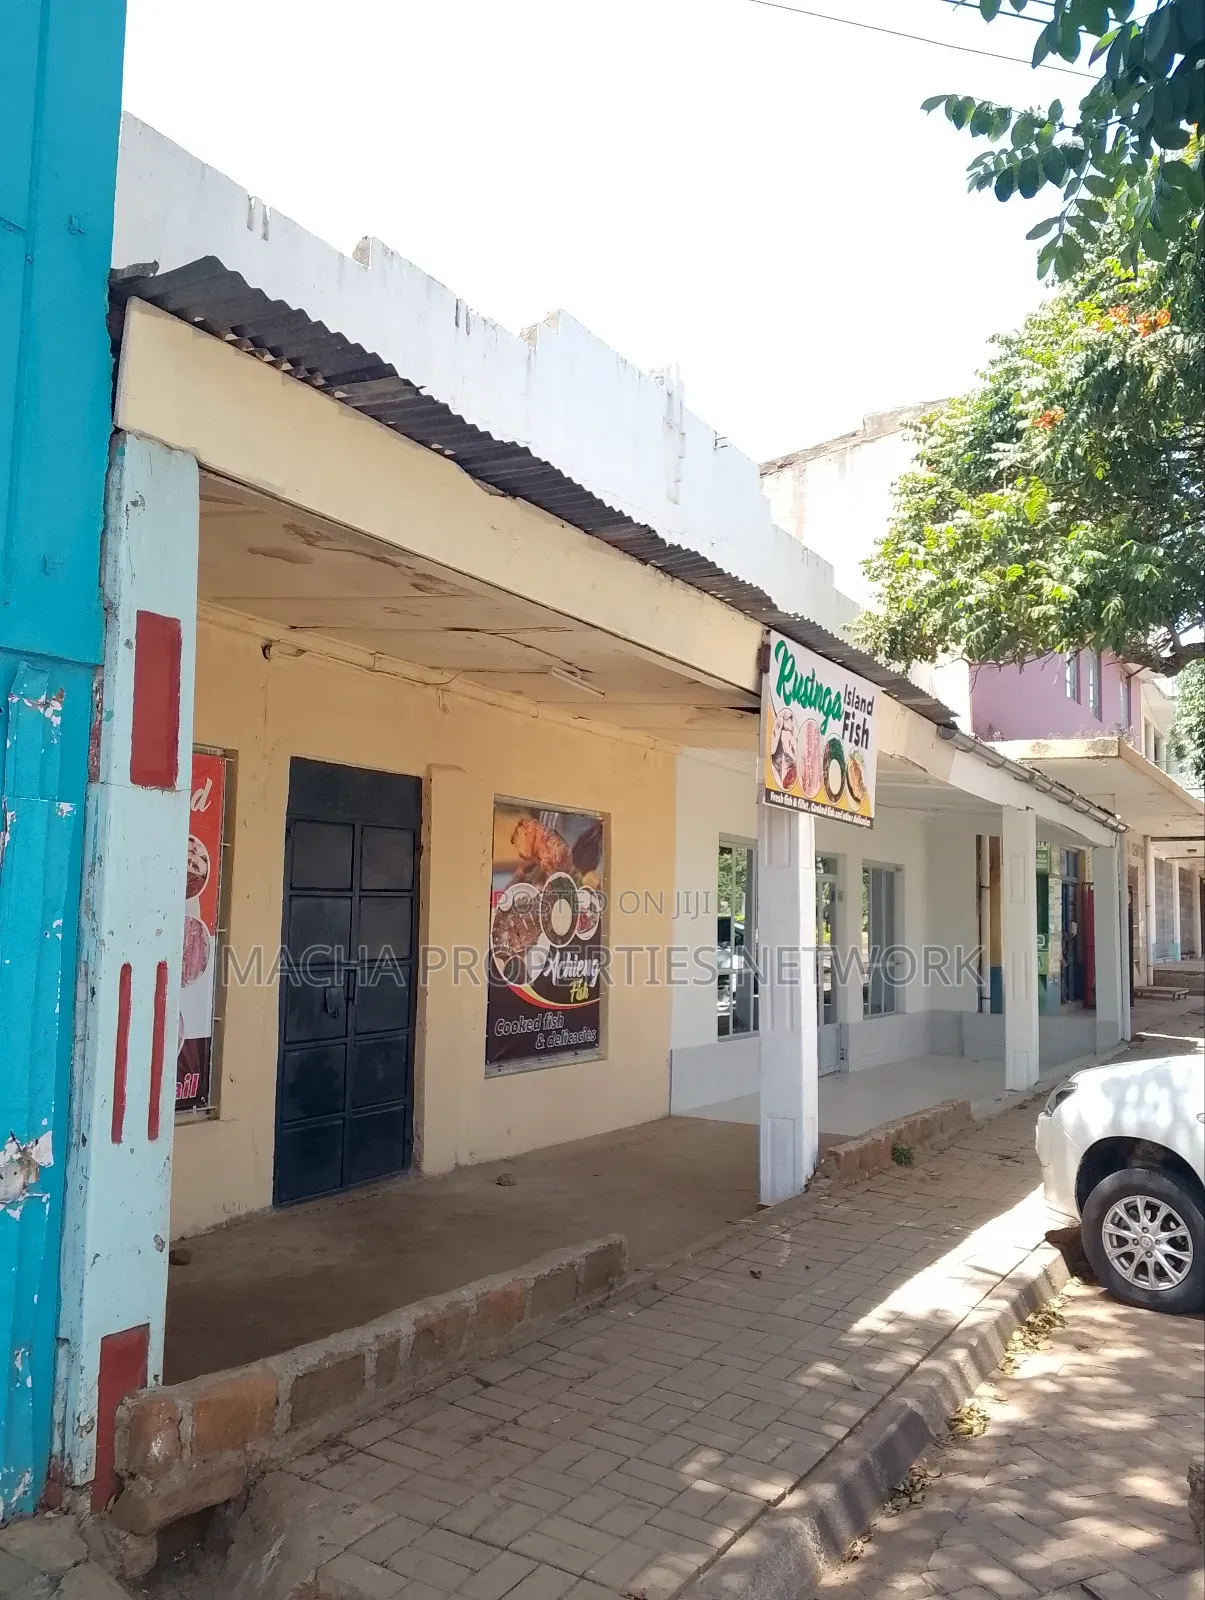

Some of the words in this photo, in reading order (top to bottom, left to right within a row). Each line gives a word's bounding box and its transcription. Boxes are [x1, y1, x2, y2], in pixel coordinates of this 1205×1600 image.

[775, 640, 844, 736] Rusinga
[844, 684, 875, 716] Island
[842, 710, 870, 750] Fish
[770, 791, 784, 804] Fresh
[811, 802, 827, 815] Cooked
[543, 949, 601, 987] Achieng
[570, 978, 589, 1003] Fish
[494, 1014, 543, 1036] Cooked
[542, 1011, 565, 1030] fish
[535, 1033, 546, 1049] &
[547, 1026, 597, 1048] delicacies
